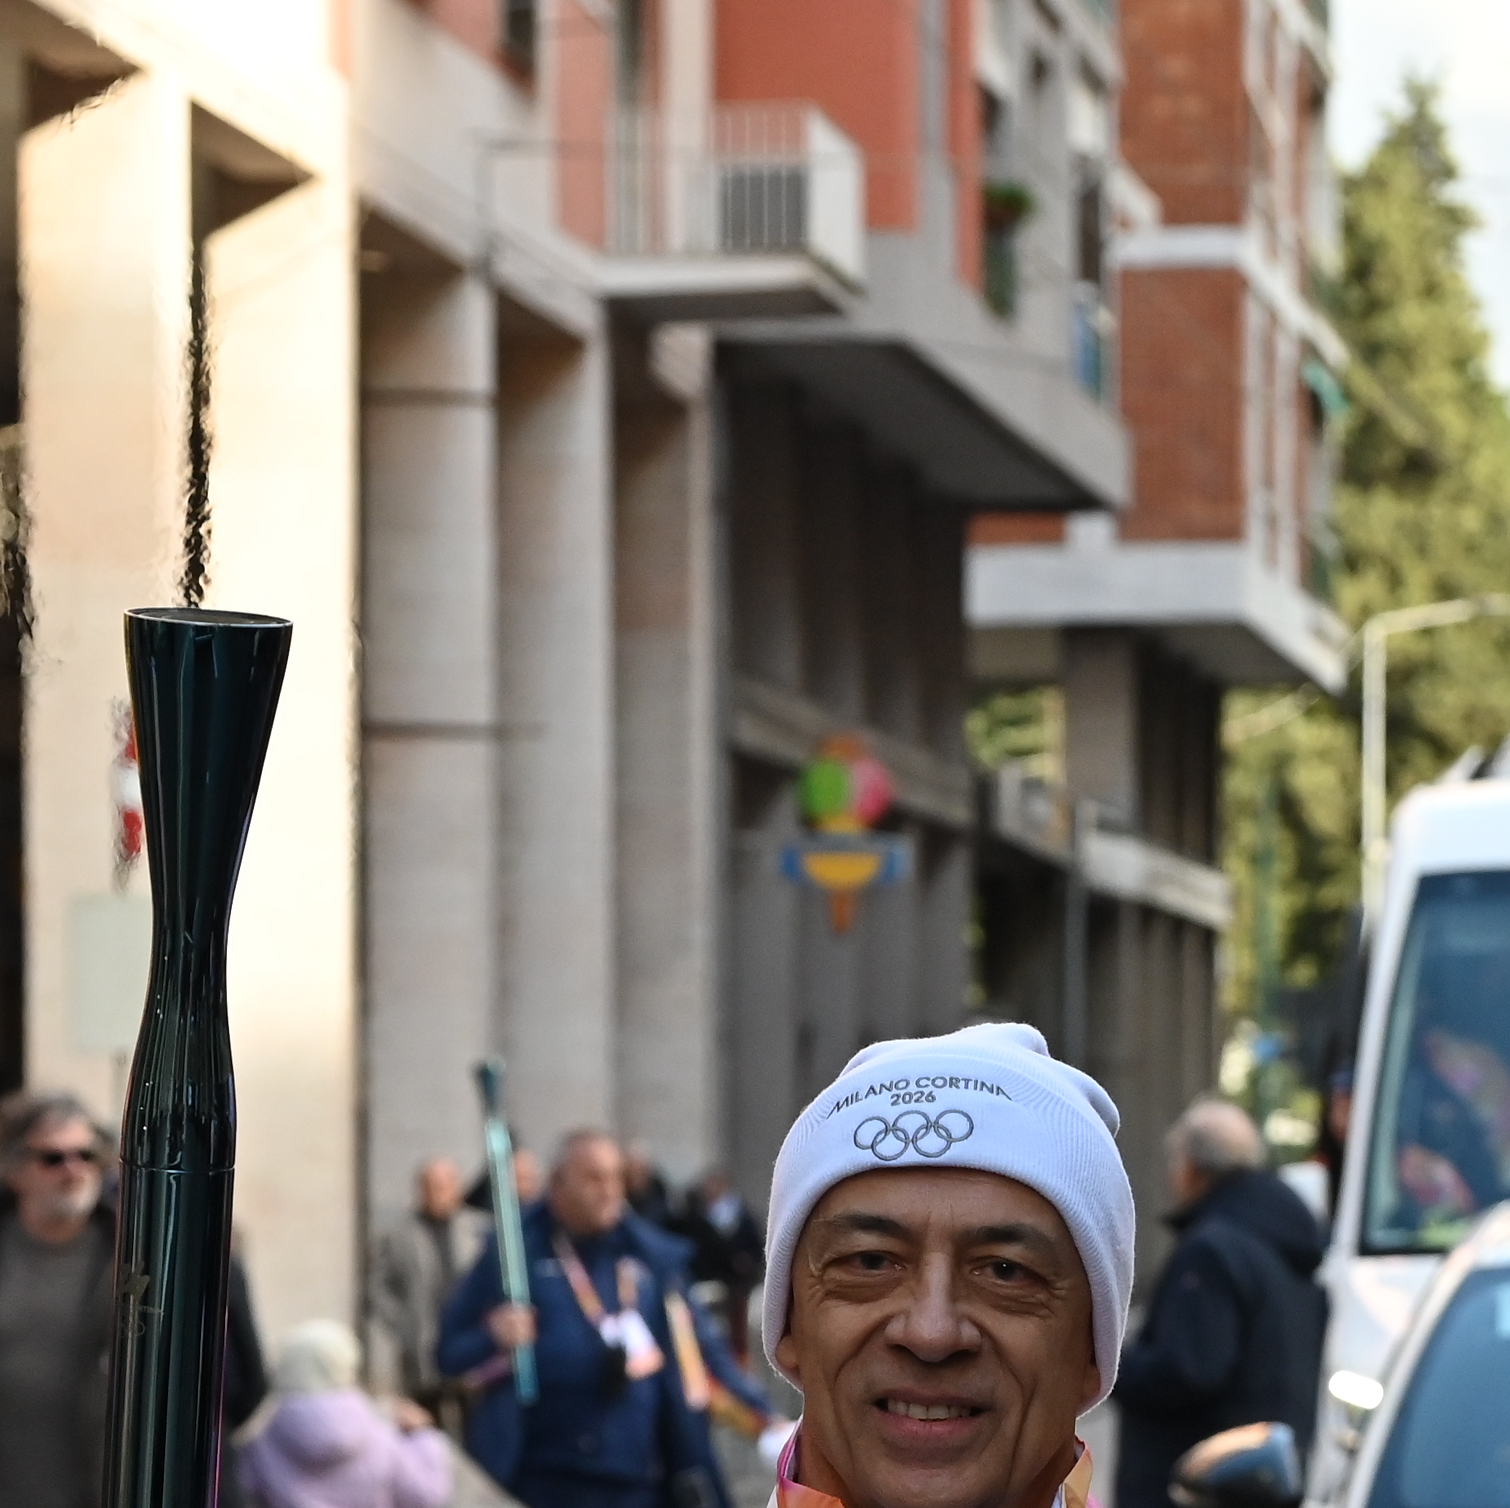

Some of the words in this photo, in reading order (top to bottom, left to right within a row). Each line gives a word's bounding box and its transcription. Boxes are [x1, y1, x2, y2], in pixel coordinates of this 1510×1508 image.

[826, 1078, 911, 1120] MILANO
[915, 1075, 1013, 1102] CORTINA
[890, 1090, 937, 1107] 2026
